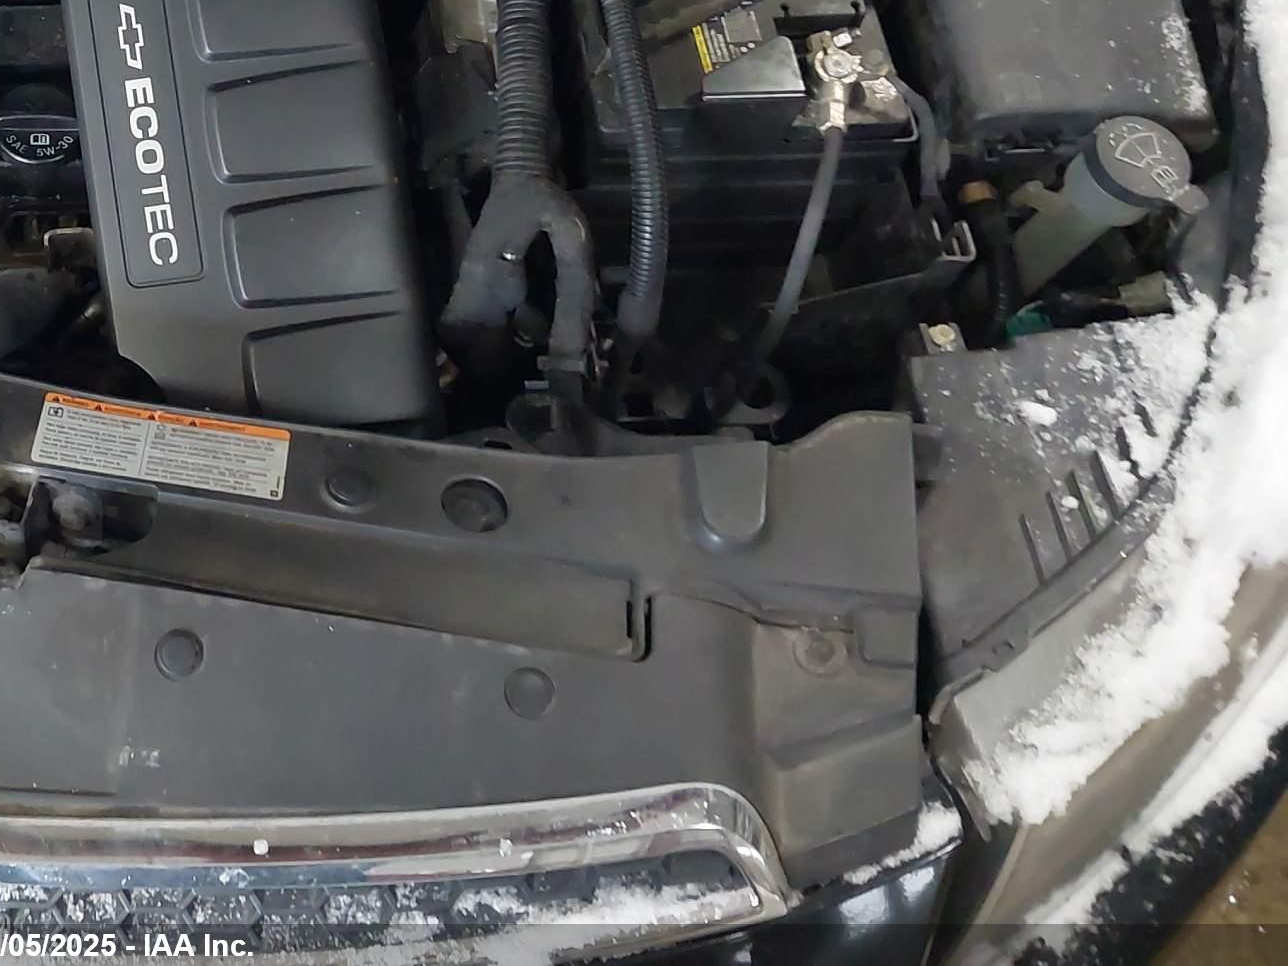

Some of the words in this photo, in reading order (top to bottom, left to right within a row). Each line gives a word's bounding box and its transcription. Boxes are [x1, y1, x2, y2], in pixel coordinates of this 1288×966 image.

[6, 135, 27, 154] SAE
[36, 136, 74, 157] 5W-30
[125, 77, 178, 265] ECOTEC
